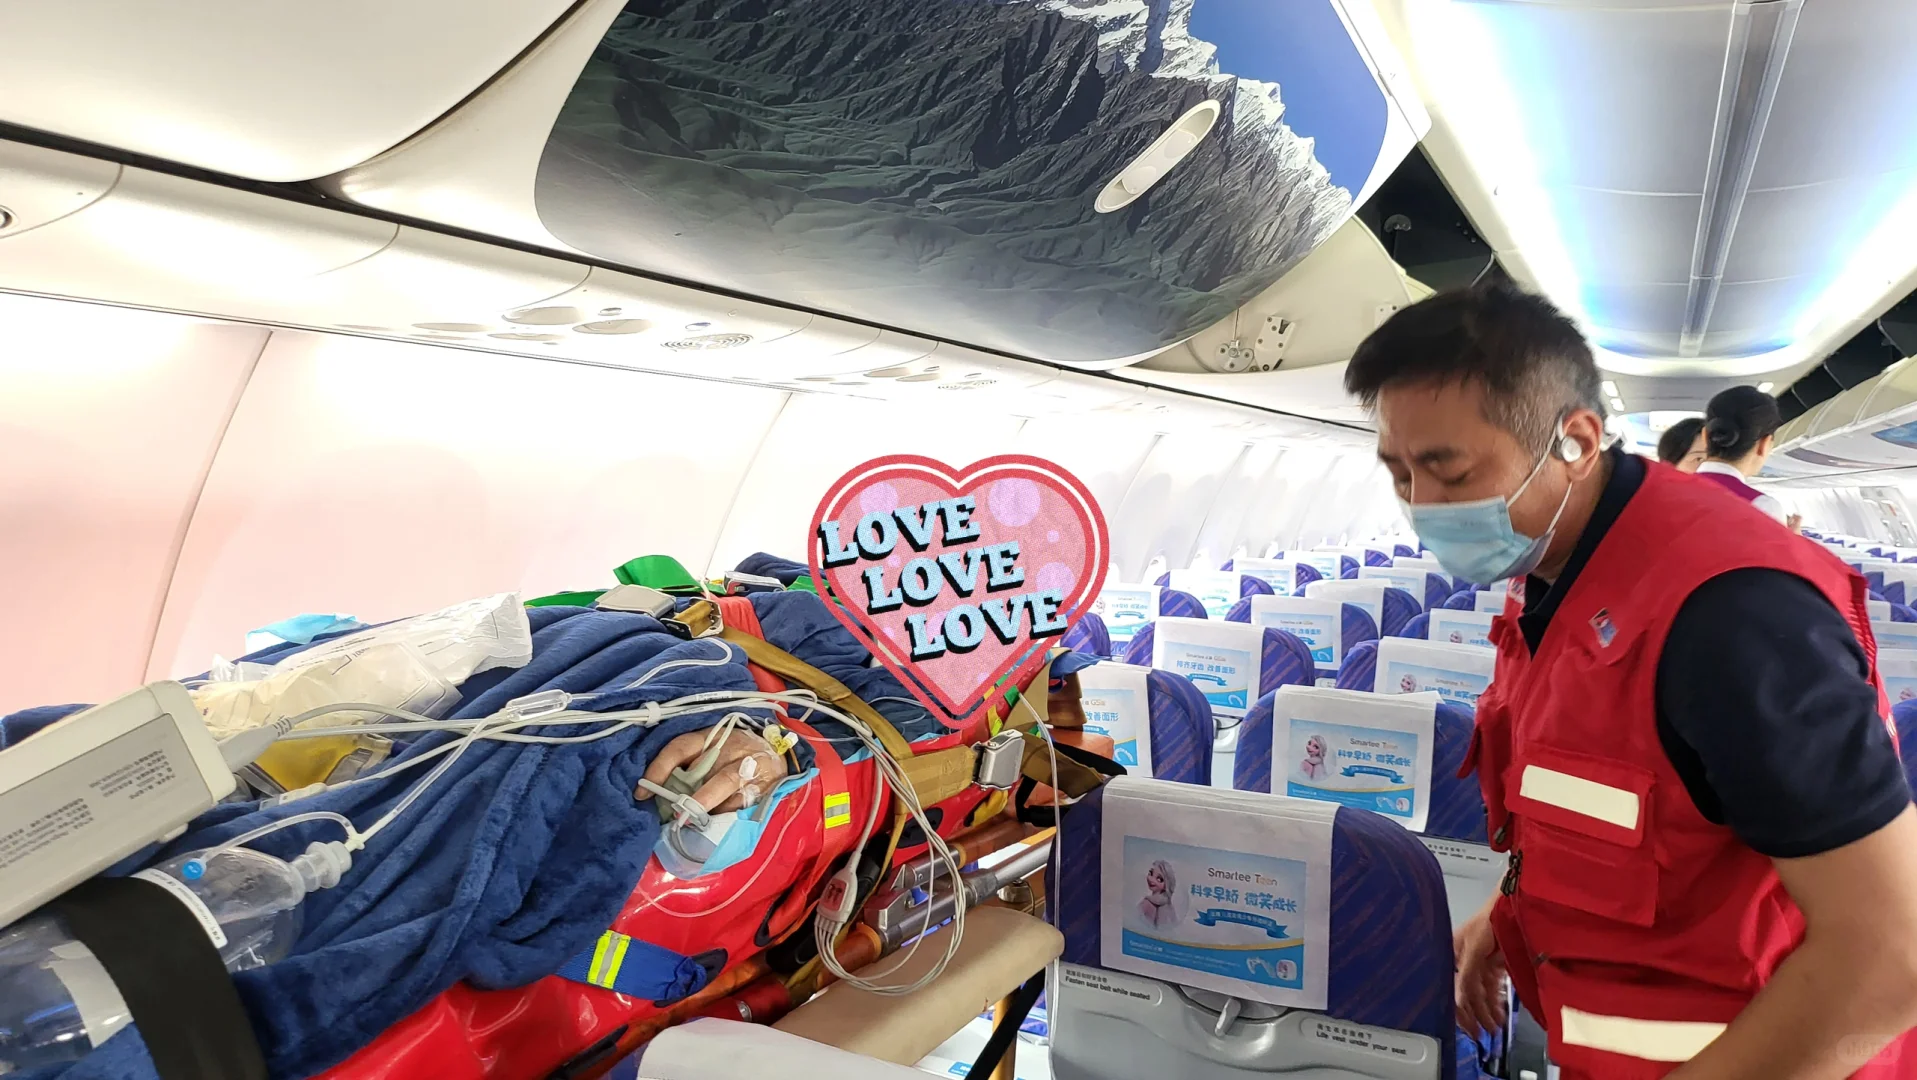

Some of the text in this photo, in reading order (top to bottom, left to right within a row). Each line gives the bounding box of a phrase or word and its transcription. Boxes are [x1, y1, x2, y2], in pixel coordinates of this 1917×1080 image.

[1349, 738, 1380, 749] Smartee
[1207, 867, 1278, 887] Smartee Teen
[1190, 883, 1298, 914] 科学早矫 微笑成长
[1065, 975, 1151, 1001] Fasten seat belt while seated
[1348, 1039, 1369, 1047] under
